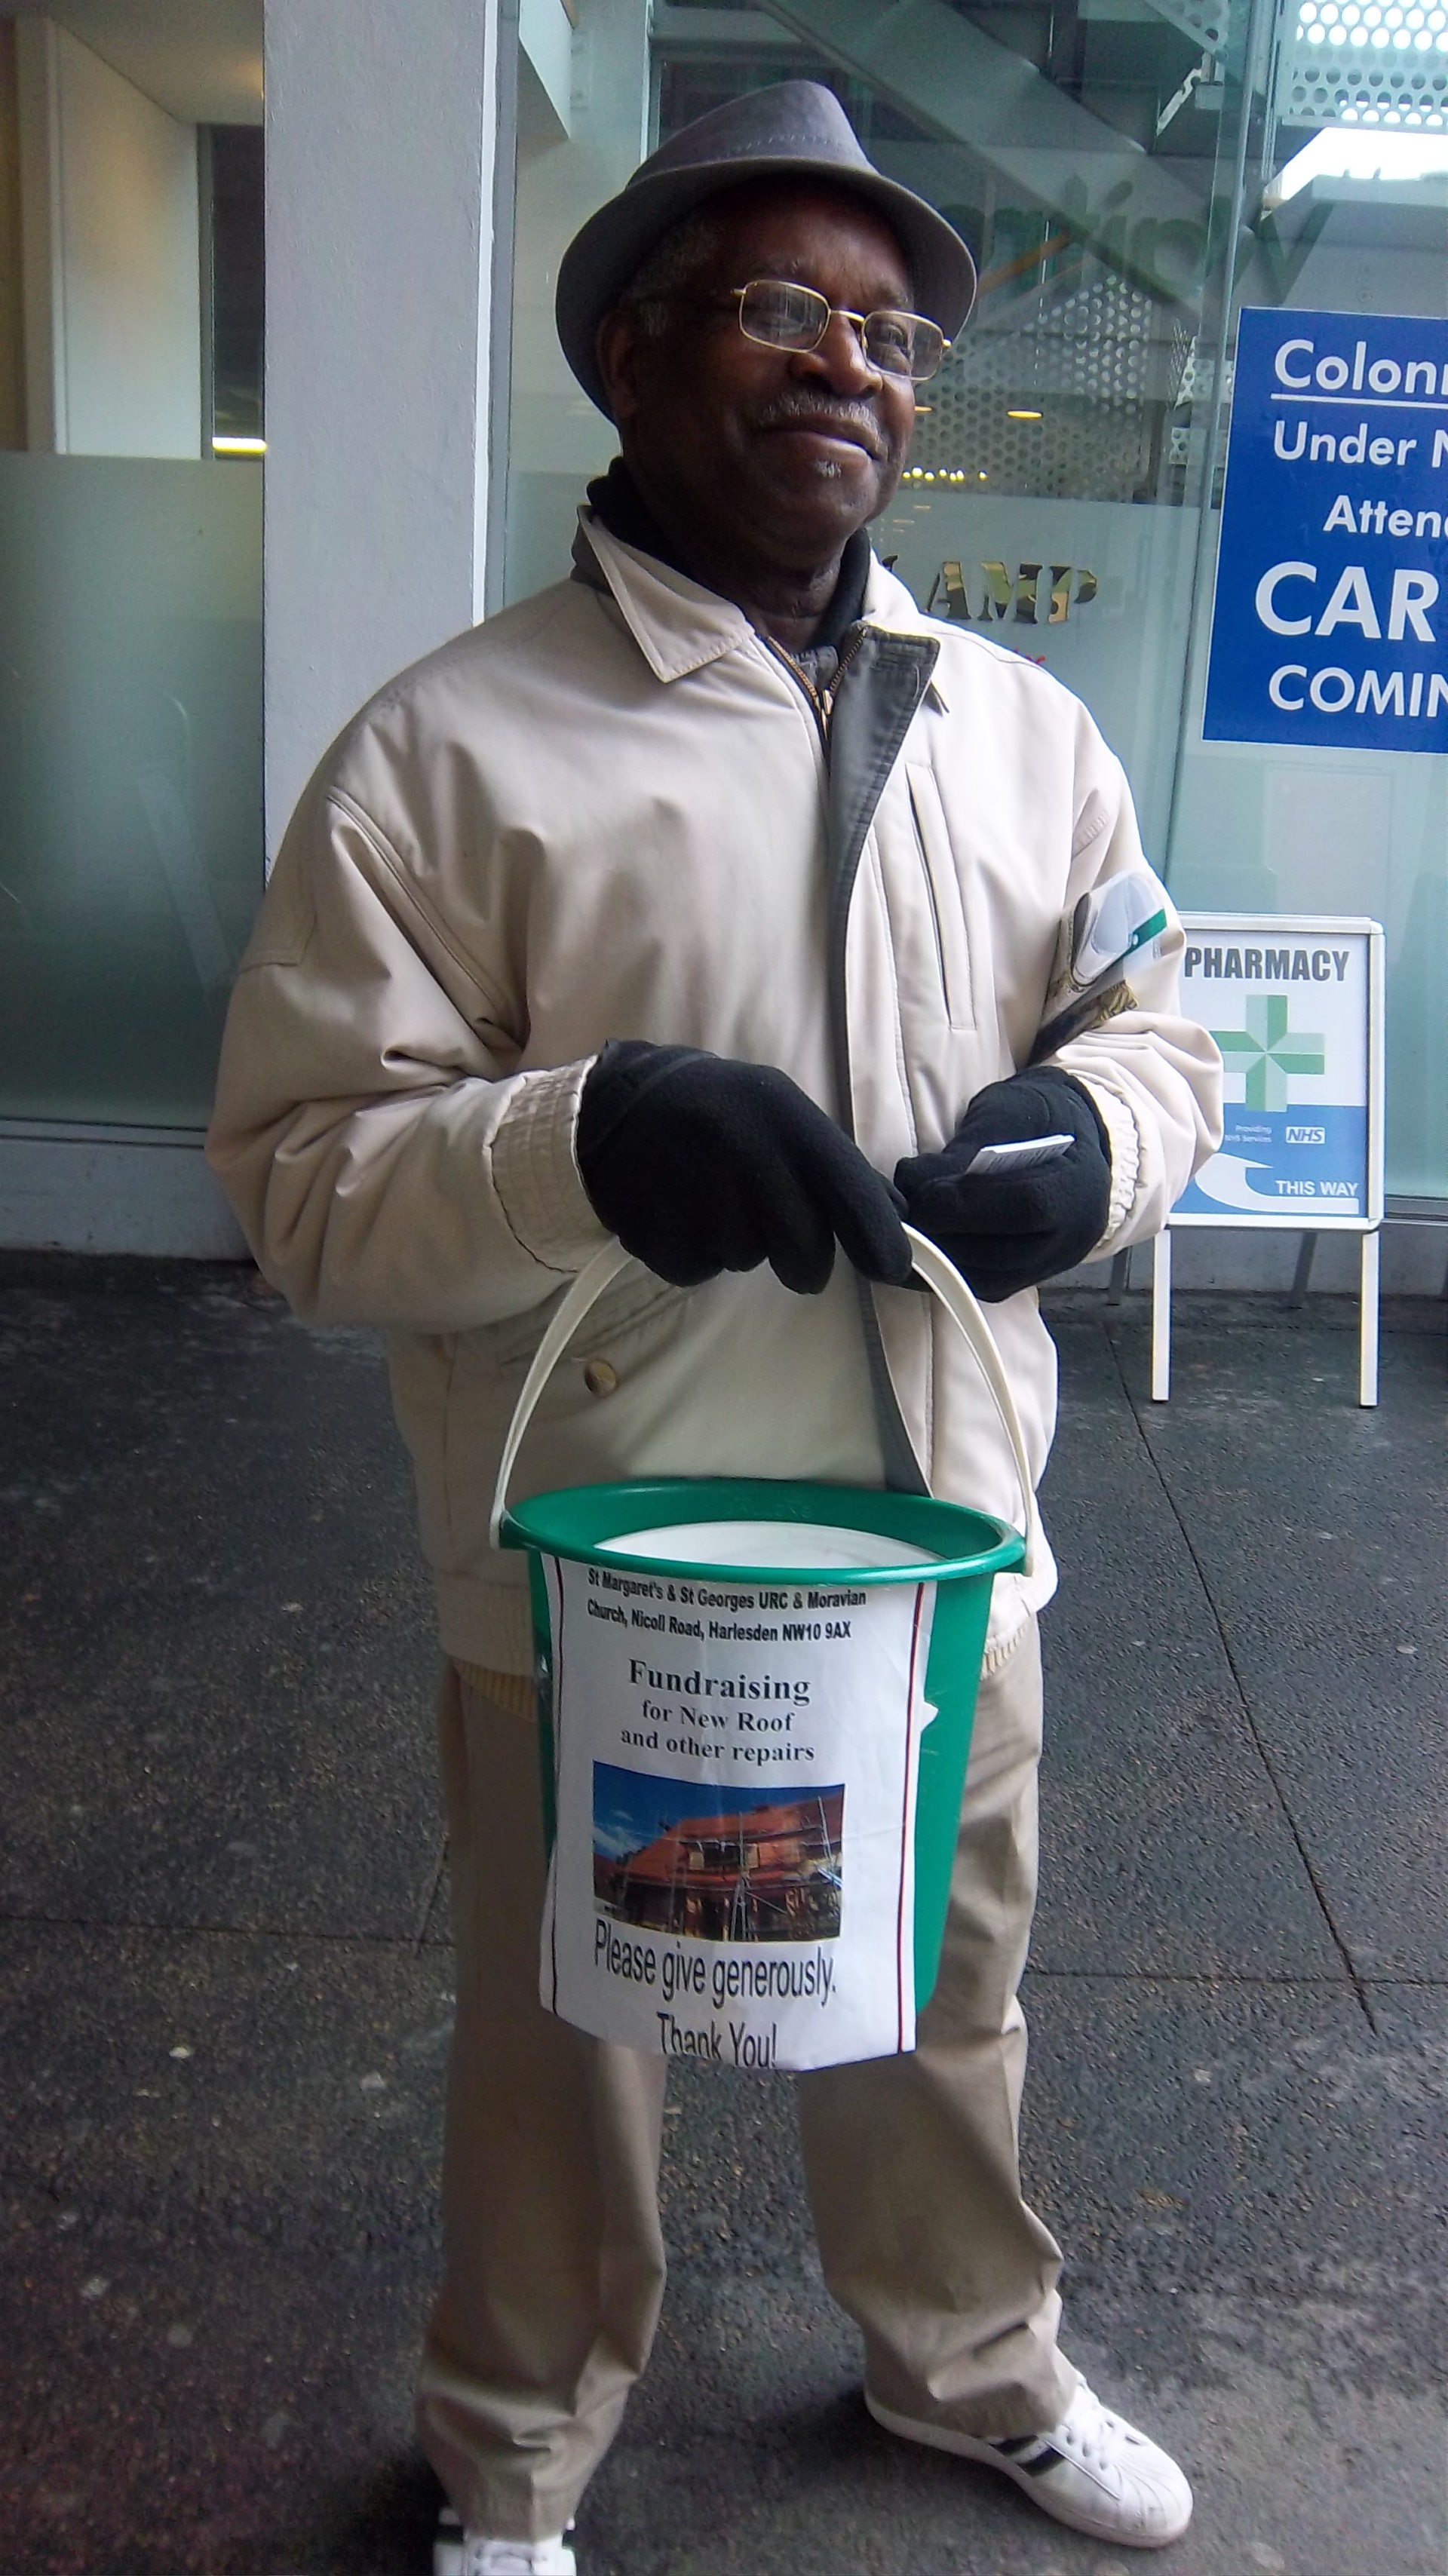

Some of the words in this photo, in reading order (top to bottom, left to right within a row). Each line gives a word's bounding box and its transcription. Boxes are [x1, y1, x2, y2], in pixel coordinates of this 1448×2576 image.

[1275, 339, 1448, 396] Colon
[1273, 420, 1416, 468] Under
[1323, 495, 1448, 538] Atten
[882, 554, 1098, 624] AMP
[1255, 560, 1439, 642] CAR
[1185, 946, 1349, 982] PHARMACY
[1287, 1128, 1323, 1142] NHS
[1275, 1180, 1315, 1196] THIS
[1320, 1181, 1359, 1197] WAY
[588, 1567, 600, 1587] St
[603, 1571, 664, 1599] Margaret's
[667, 1584, 676, 1602] &
[680, 1586, 695, 1605] St
[698, 1588, 755, 1613] Georges
[759, 1591, 788, 1610] URC
[792, 1592, 803, 1610] &
[808, 1588, 867, 1610] Moravian
[587, 1598, 627, 1628] Church,
[631, 1608, 665, 1633] Nicoll
[669, 1615, 705, 1642] Road,
[709, 1620, 778, 1642] Harlesden
[782, 1623, 821, 1642] NW10
[825, 1620, 851, 1640] 9AX
[628, 1658, 811, 1707] Fundraising
[642, 1698, 673, 1722] for
[680, 1705, 730, 1730] New
[738, 1711, 796, 1732] Roof
[621, 1728, 659, 1750] and
[666, 1735, 725, 1759] other
[732, 1742, 814, 1767] repairs
[595, 1919, 656, 1986] Please
[661, 1941, 706, 2002] give
[712, 1946, 837, 2009] generously.
[656, 2011, 722, 2060] Thank
[729, 2021, 778, 2068] You!
